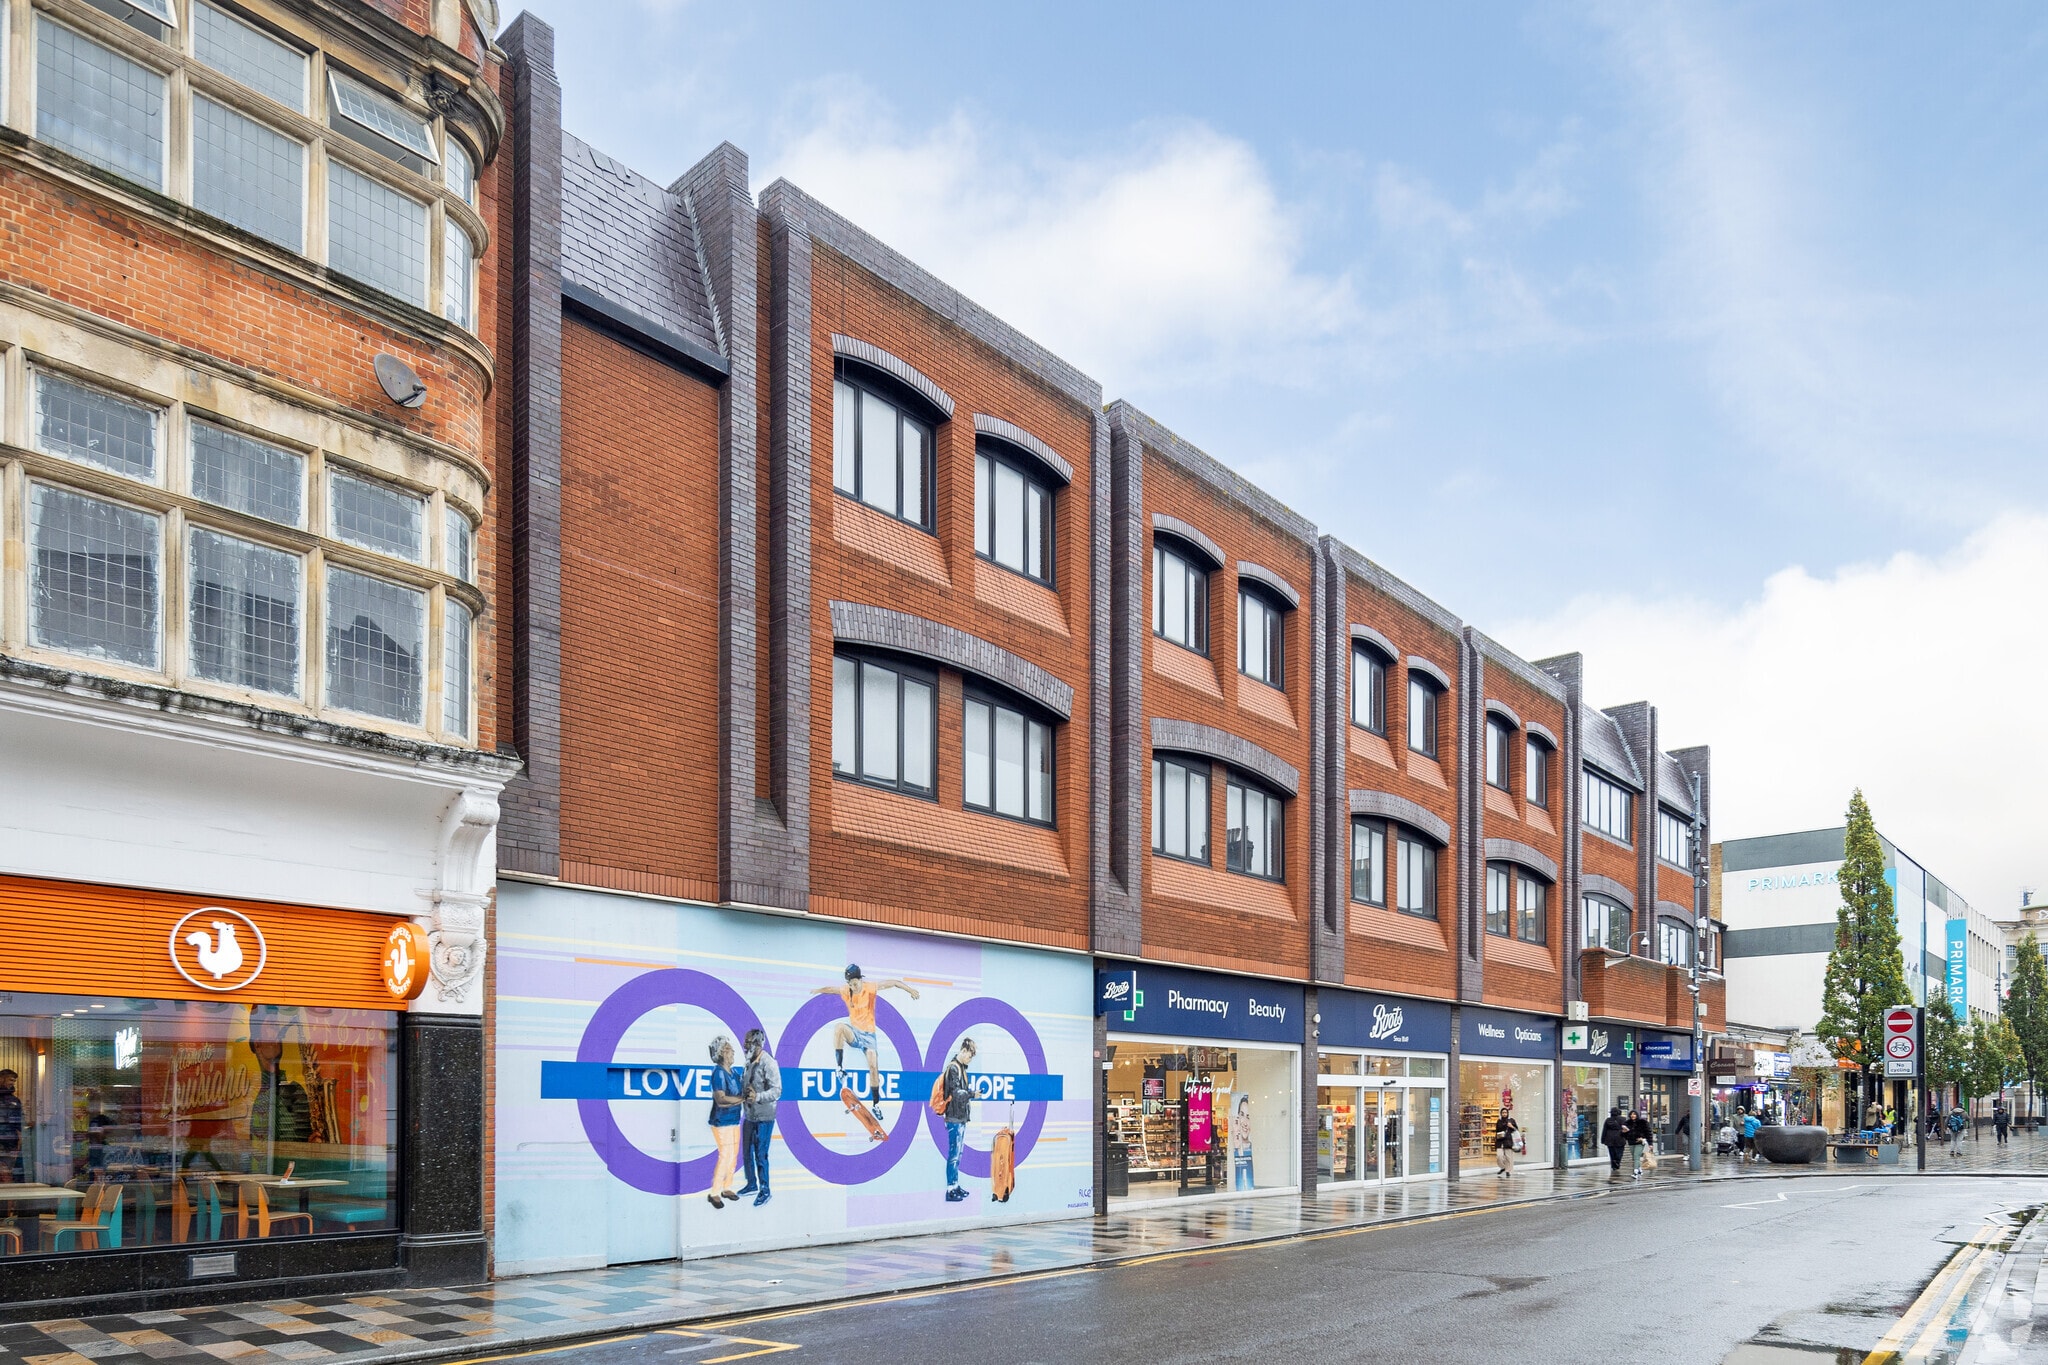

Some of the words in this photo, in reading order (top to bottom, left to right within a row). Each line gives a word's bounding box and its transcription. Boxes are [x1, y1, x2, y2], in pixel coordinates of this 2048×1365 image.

[1749, 871, 1838, 891] PRIMARK
[1950, 941, 1963, 1004] PRIMARK
[1103, 981, 1129, 999] Boots
[1168, 990, 1229, 1018] Pharmacy
[1249, 998, 1286, 1023] Beauty
[1369, 1004, 1403, 1040] Boots
[1478, 1023, 1505, 1038] Wellness
[1515, 1026, 1542, 1043] Opticians
[1590, 1029, 1608, 1056] Boots
[160, 1063, 250, 1118] Louisiana
[623, 1068, 713, 1098] LOVE
